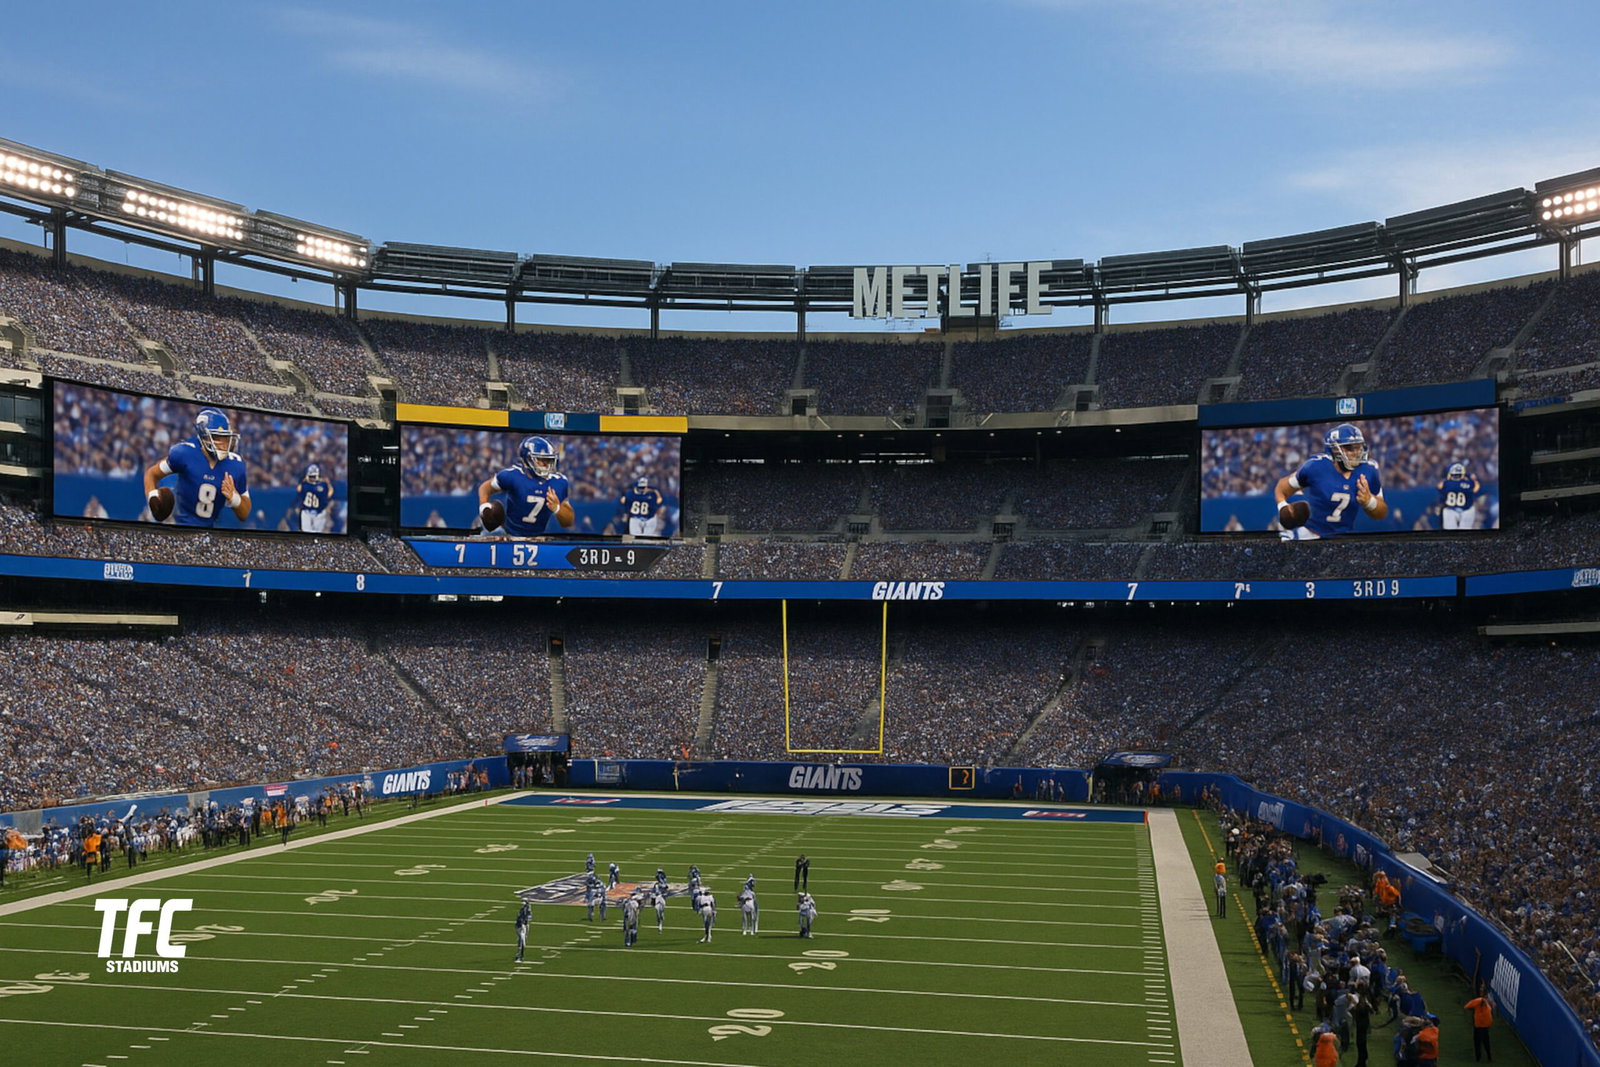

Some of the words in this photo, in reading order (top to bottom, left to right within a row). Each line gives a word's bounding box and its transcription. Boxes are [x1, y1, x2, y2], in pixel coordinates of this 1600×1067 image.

[853, 261, 1053, 318] METLIFE
[196, 483, 217, 518] 8
[522, 495, 545, 523] 7
[1326, 492, 1351, 522] 7
[490, 545, 497, 566] 1
[513, 544, 539, 566] 52
[580, 549, 610, 565] 3RD
[627, 550, 635, 565] 9
[356, 574, 365, 591] 8
[712, 581, 723, 599] 7
[872, 581, 946, 600] GIANTS
[1127, 582, 1139, 600] 7
[1305, 582, 1315, 598] 3
[1353, 581, 1386, 597] 3RD
[1391, 580, 1399, 595] 9
[382, 770, 432, 795] GIANTS
[788, 765, 863, 790] GIANTS
